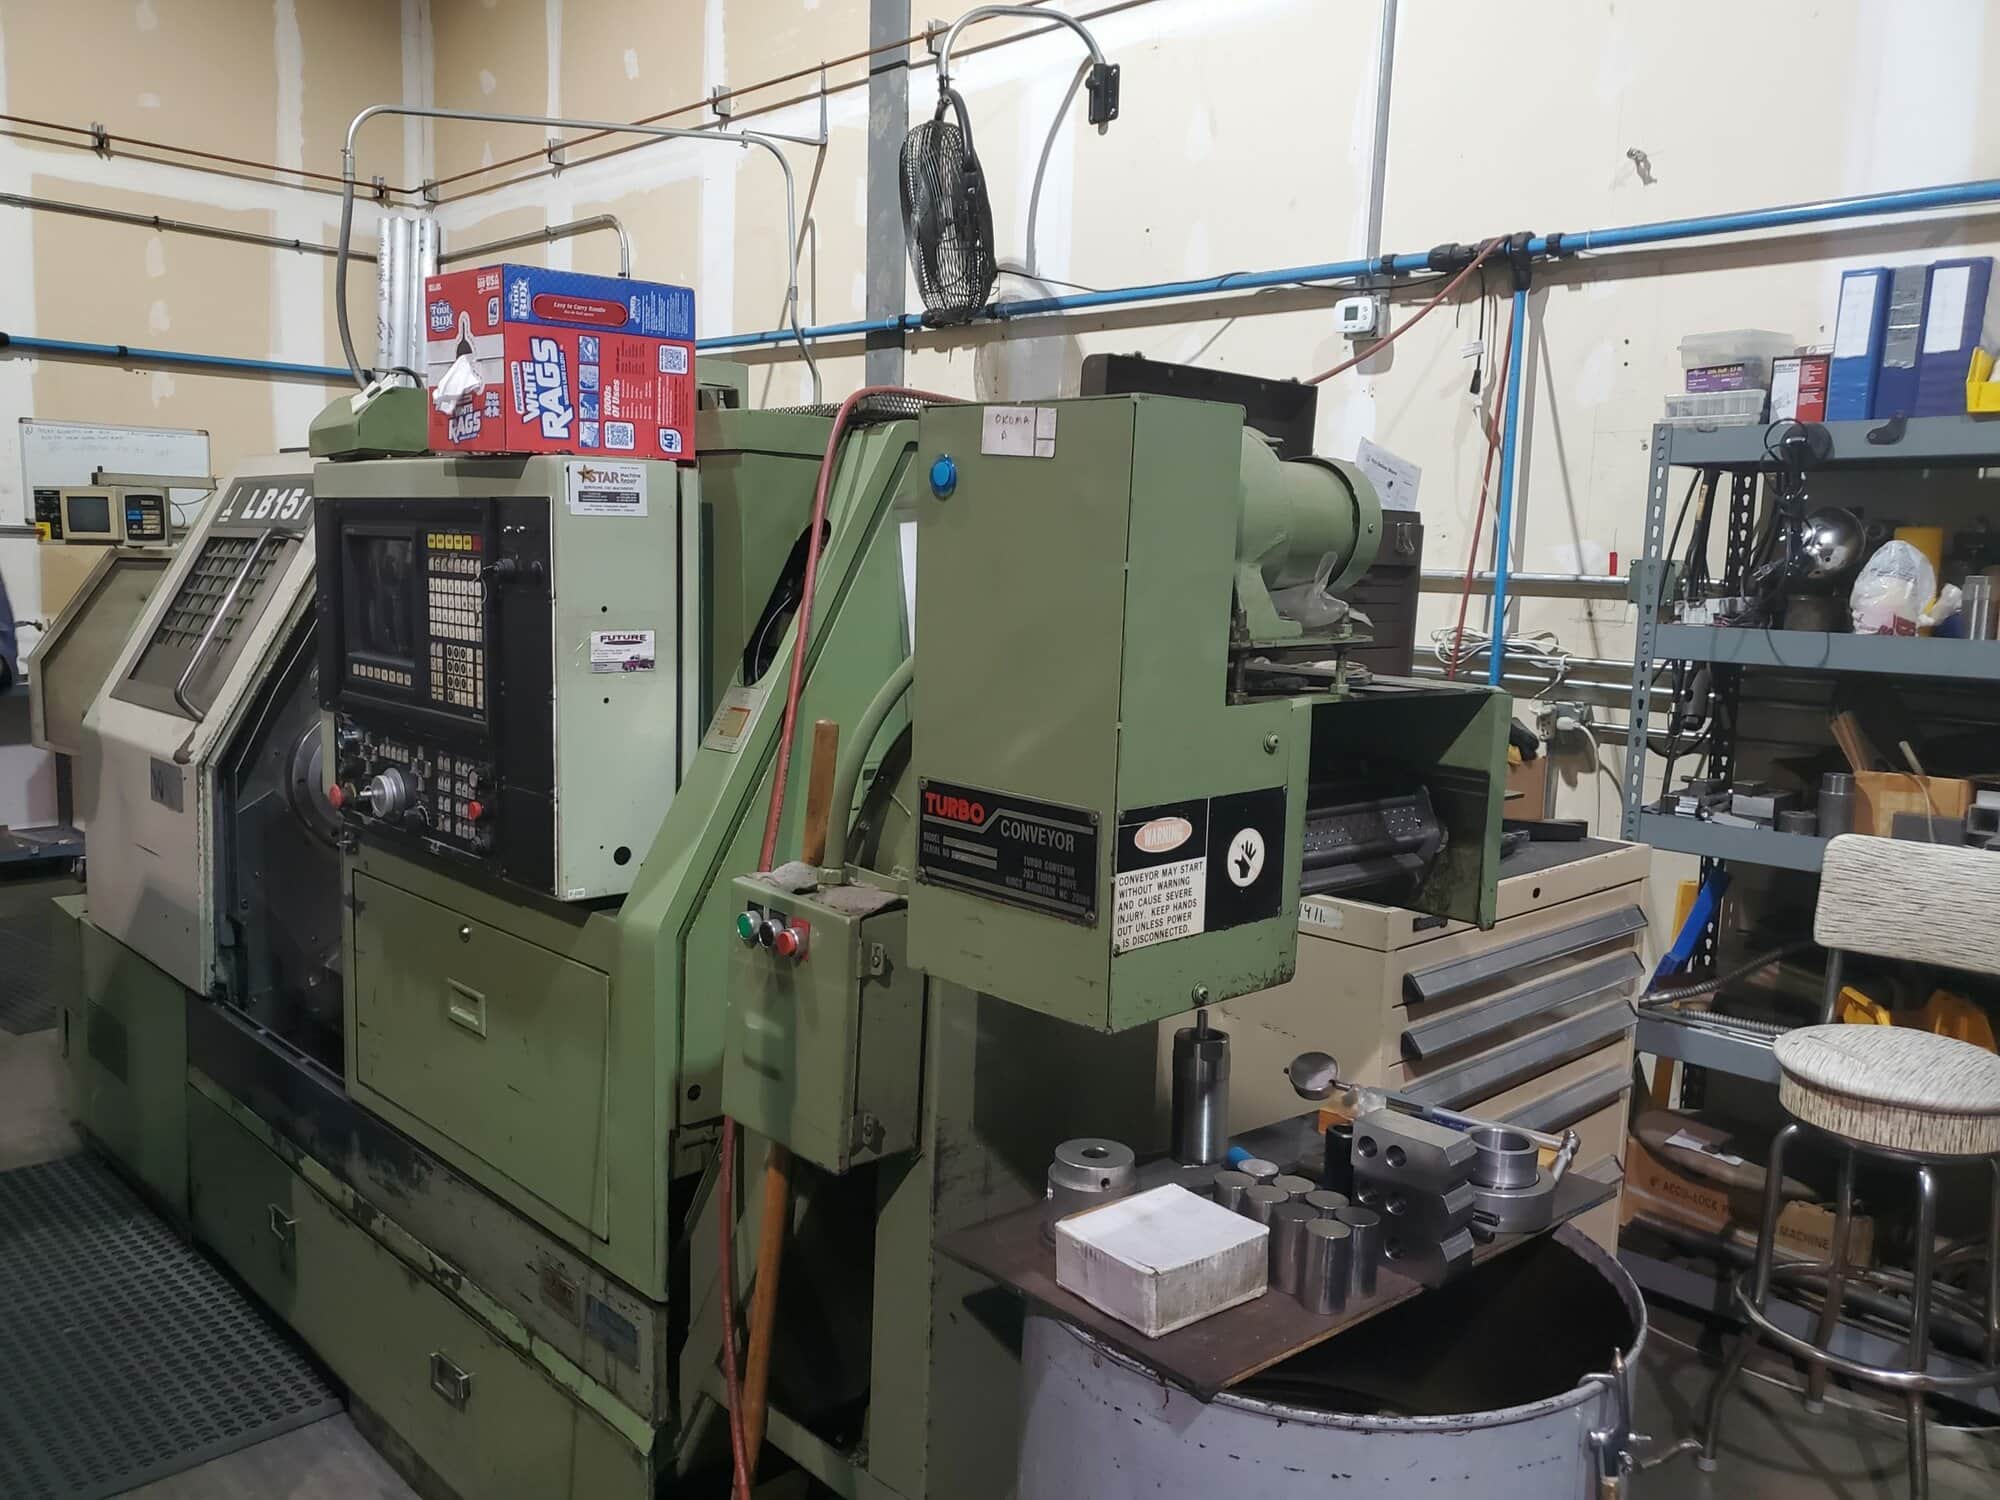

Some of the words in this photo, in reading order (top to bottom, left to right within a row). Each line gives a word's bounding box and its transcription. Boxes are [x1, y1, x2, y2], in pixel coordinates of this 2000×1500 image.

[430, 301, 451, 315] TOOL
[511, 284, 519, 317] TOOL
[519, 279, 529, 317] BOX
[573, 303, 588, 312] Carry
[431, 314, 453, 329] BOX
[522, 361, 541, 423] WHITE
[531, 338, 574, 438] RAGS
[612, 379, 620, 403] Uses
[604, 385, 613, 416] 1000s
[448, 411, 481, 444] RAGS
[995, 413, 1030, 424] OKUMA
[664, 433, 674, 449] 40
[590, 471, 619, 483] STAR
[600, 634, 647, 642] FUTURE
[925, 791, 985, 825] TURBO
[1001, 819, 1074, 853] CONVEYOR
[1119, 870, 1159, 887] CONVEYOR
[1162, 866, 1178, 878] MAY
[1180, 861, 1203, 874] START
[1118, 900, 1135, 912] AND
[1138, 894, 1162, 908] CAUSE
[1166, 887, 1192, 901] SEVERE
[1119, 884, 1152, 899] WITHOUT
[1157, 876, 1190, 891] WARNING
[1151, 904, 1170, 916] KEEP
[1173, 898, 1197, 912] HANDS
[1117, 925, 1132, 937] OUT
[1135, 919, 1163, 933] UNLESS
[1167, 911, 1192, 925] POWER
[1122, 938, 1129, 949] IS
[1132, 925, 1190, 946] DISCONNECTED.
